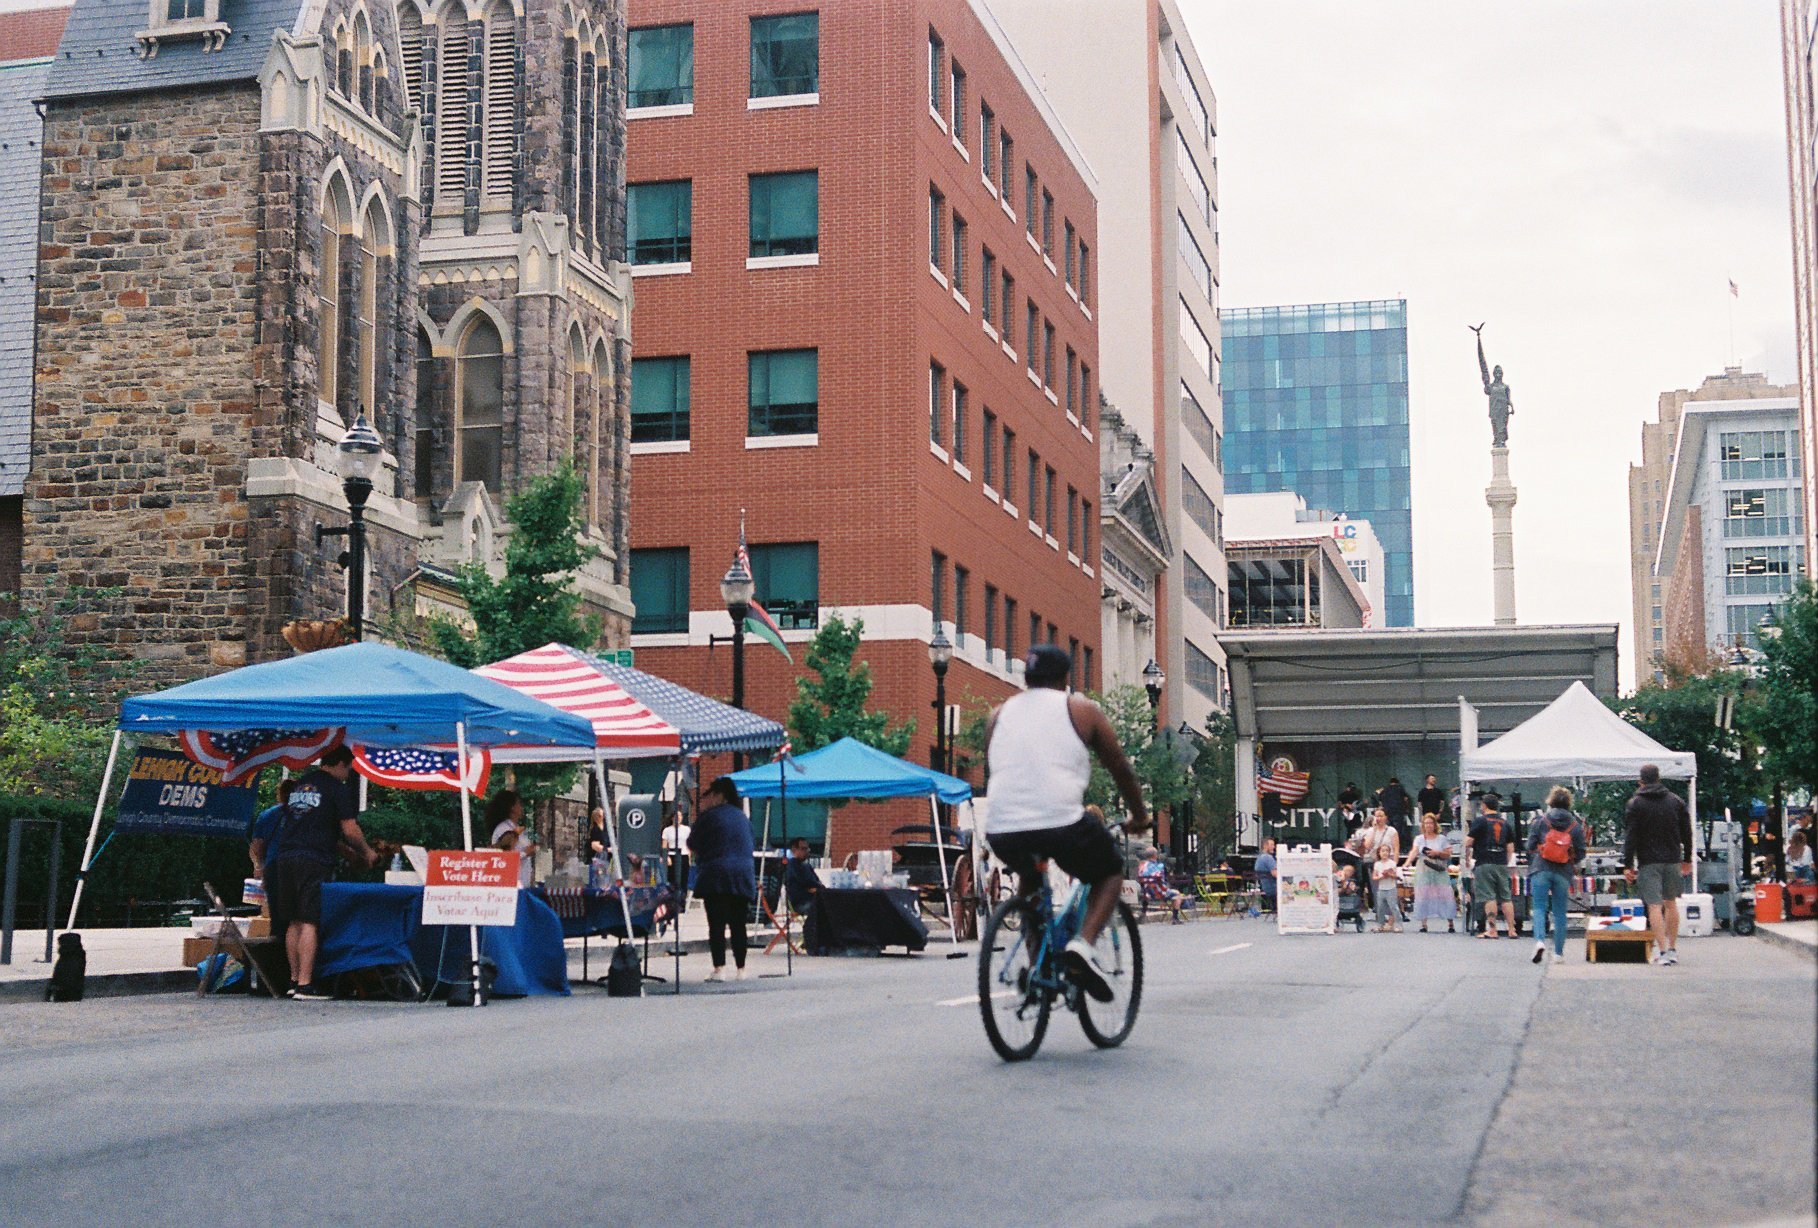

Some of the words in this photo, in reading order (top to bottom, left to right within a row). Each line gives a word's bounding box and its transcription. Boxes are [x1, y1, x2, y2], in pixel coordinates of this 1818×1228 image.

[1333, 524, 1357, 539] LC
[129, 756, 189, 782] LEHIGH
[158, 783, 208, 808] DEMS
[440, 856, 488, 871] Register
[490, 857, 507, 869] To
[442, 870, 469, 882] Vote
[471, 870, 501, 882] Here
[486, 892, 513, 903] Para
[437, 905, 467, 916] Votar
